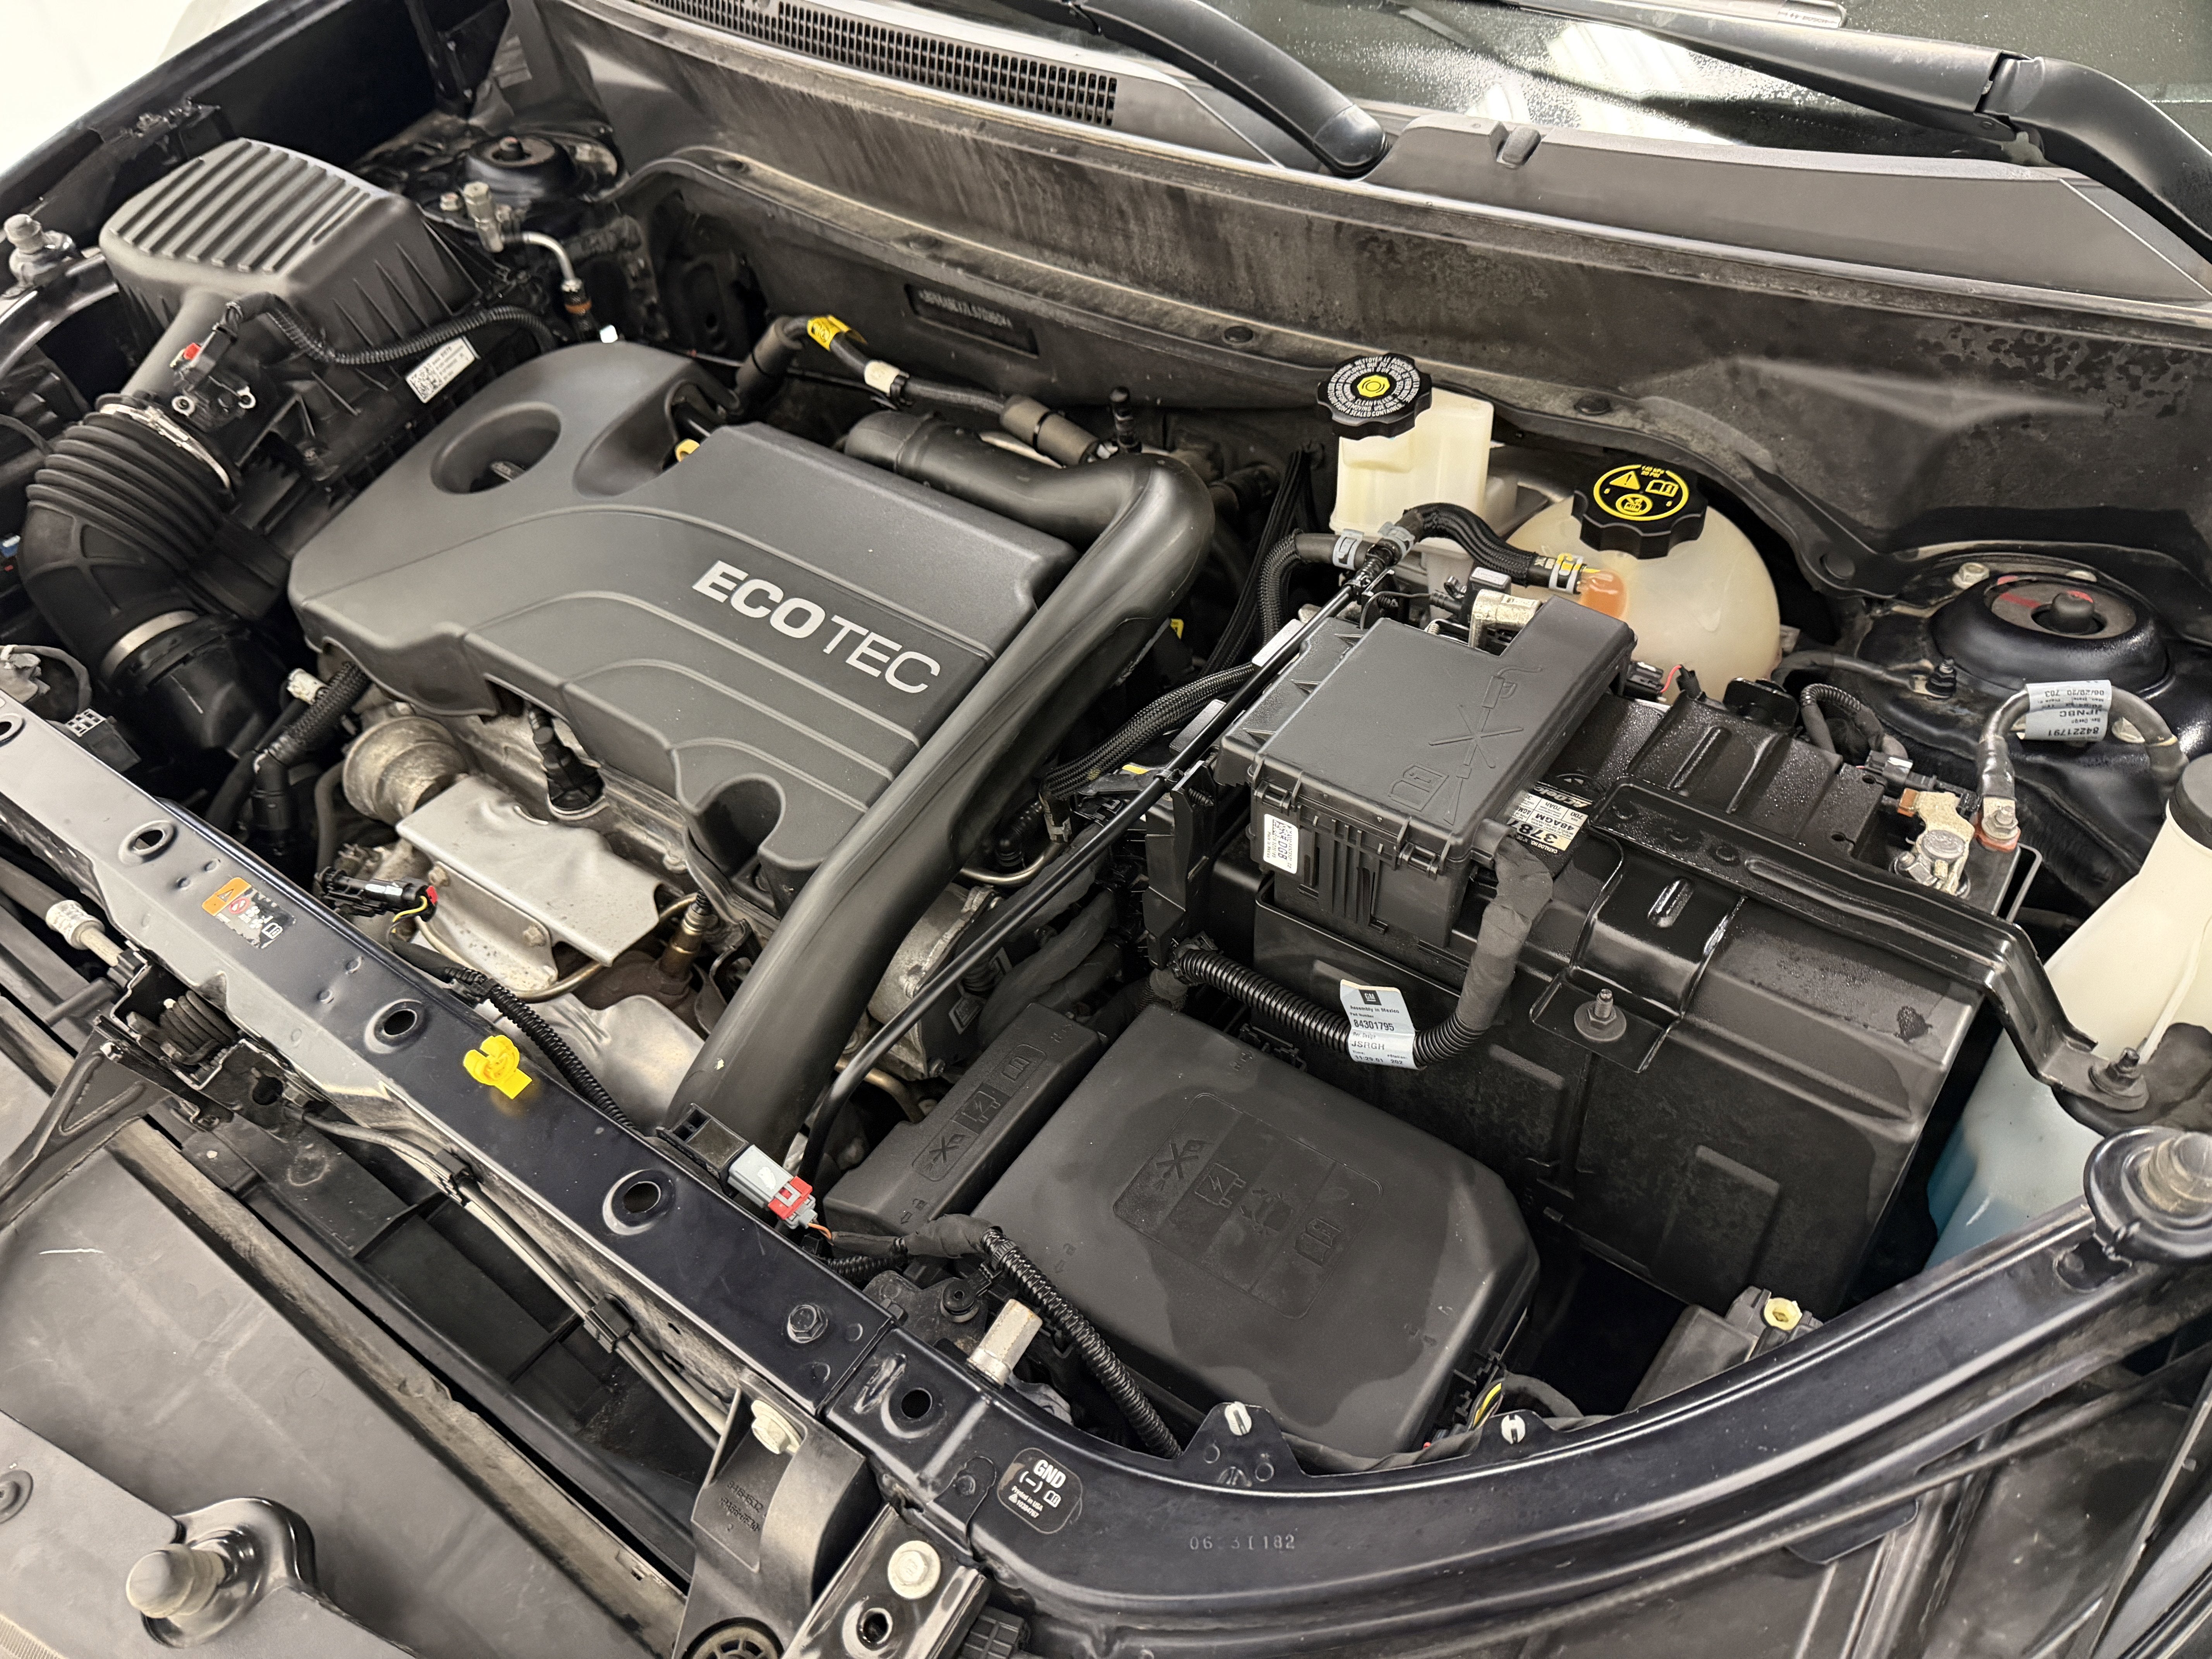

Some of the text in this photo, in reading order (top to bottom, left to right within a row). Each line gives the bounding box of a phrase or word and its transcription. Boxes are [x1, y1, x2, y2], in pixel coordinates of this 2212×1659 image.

[1355, 398, 1373, 406] CLEAN
[692, 560, 941, 693] ECOTEC
[2048, 726, 2100, 737] 84221791
[1534, 786, 1592, 808] ACDelc
[1518, 807, 1532, 815] AGM
[1545, 802, 1562, 811] 70Ah
[1535, 813, 1575, 831] 48AGM
[1278, 841, 1288, 860] DGB
[1538, 843, 1558, 854] CATALOG
[1354, 1019, 1395, 1031] 84301795
[1352, 1041, 1385, 1050] JSRGH
[1034, 1460, 1066, 1488] GND
[1012, 1486, 1029, 1501] Printed
[1032, 1501, 1043, 1511] USA
